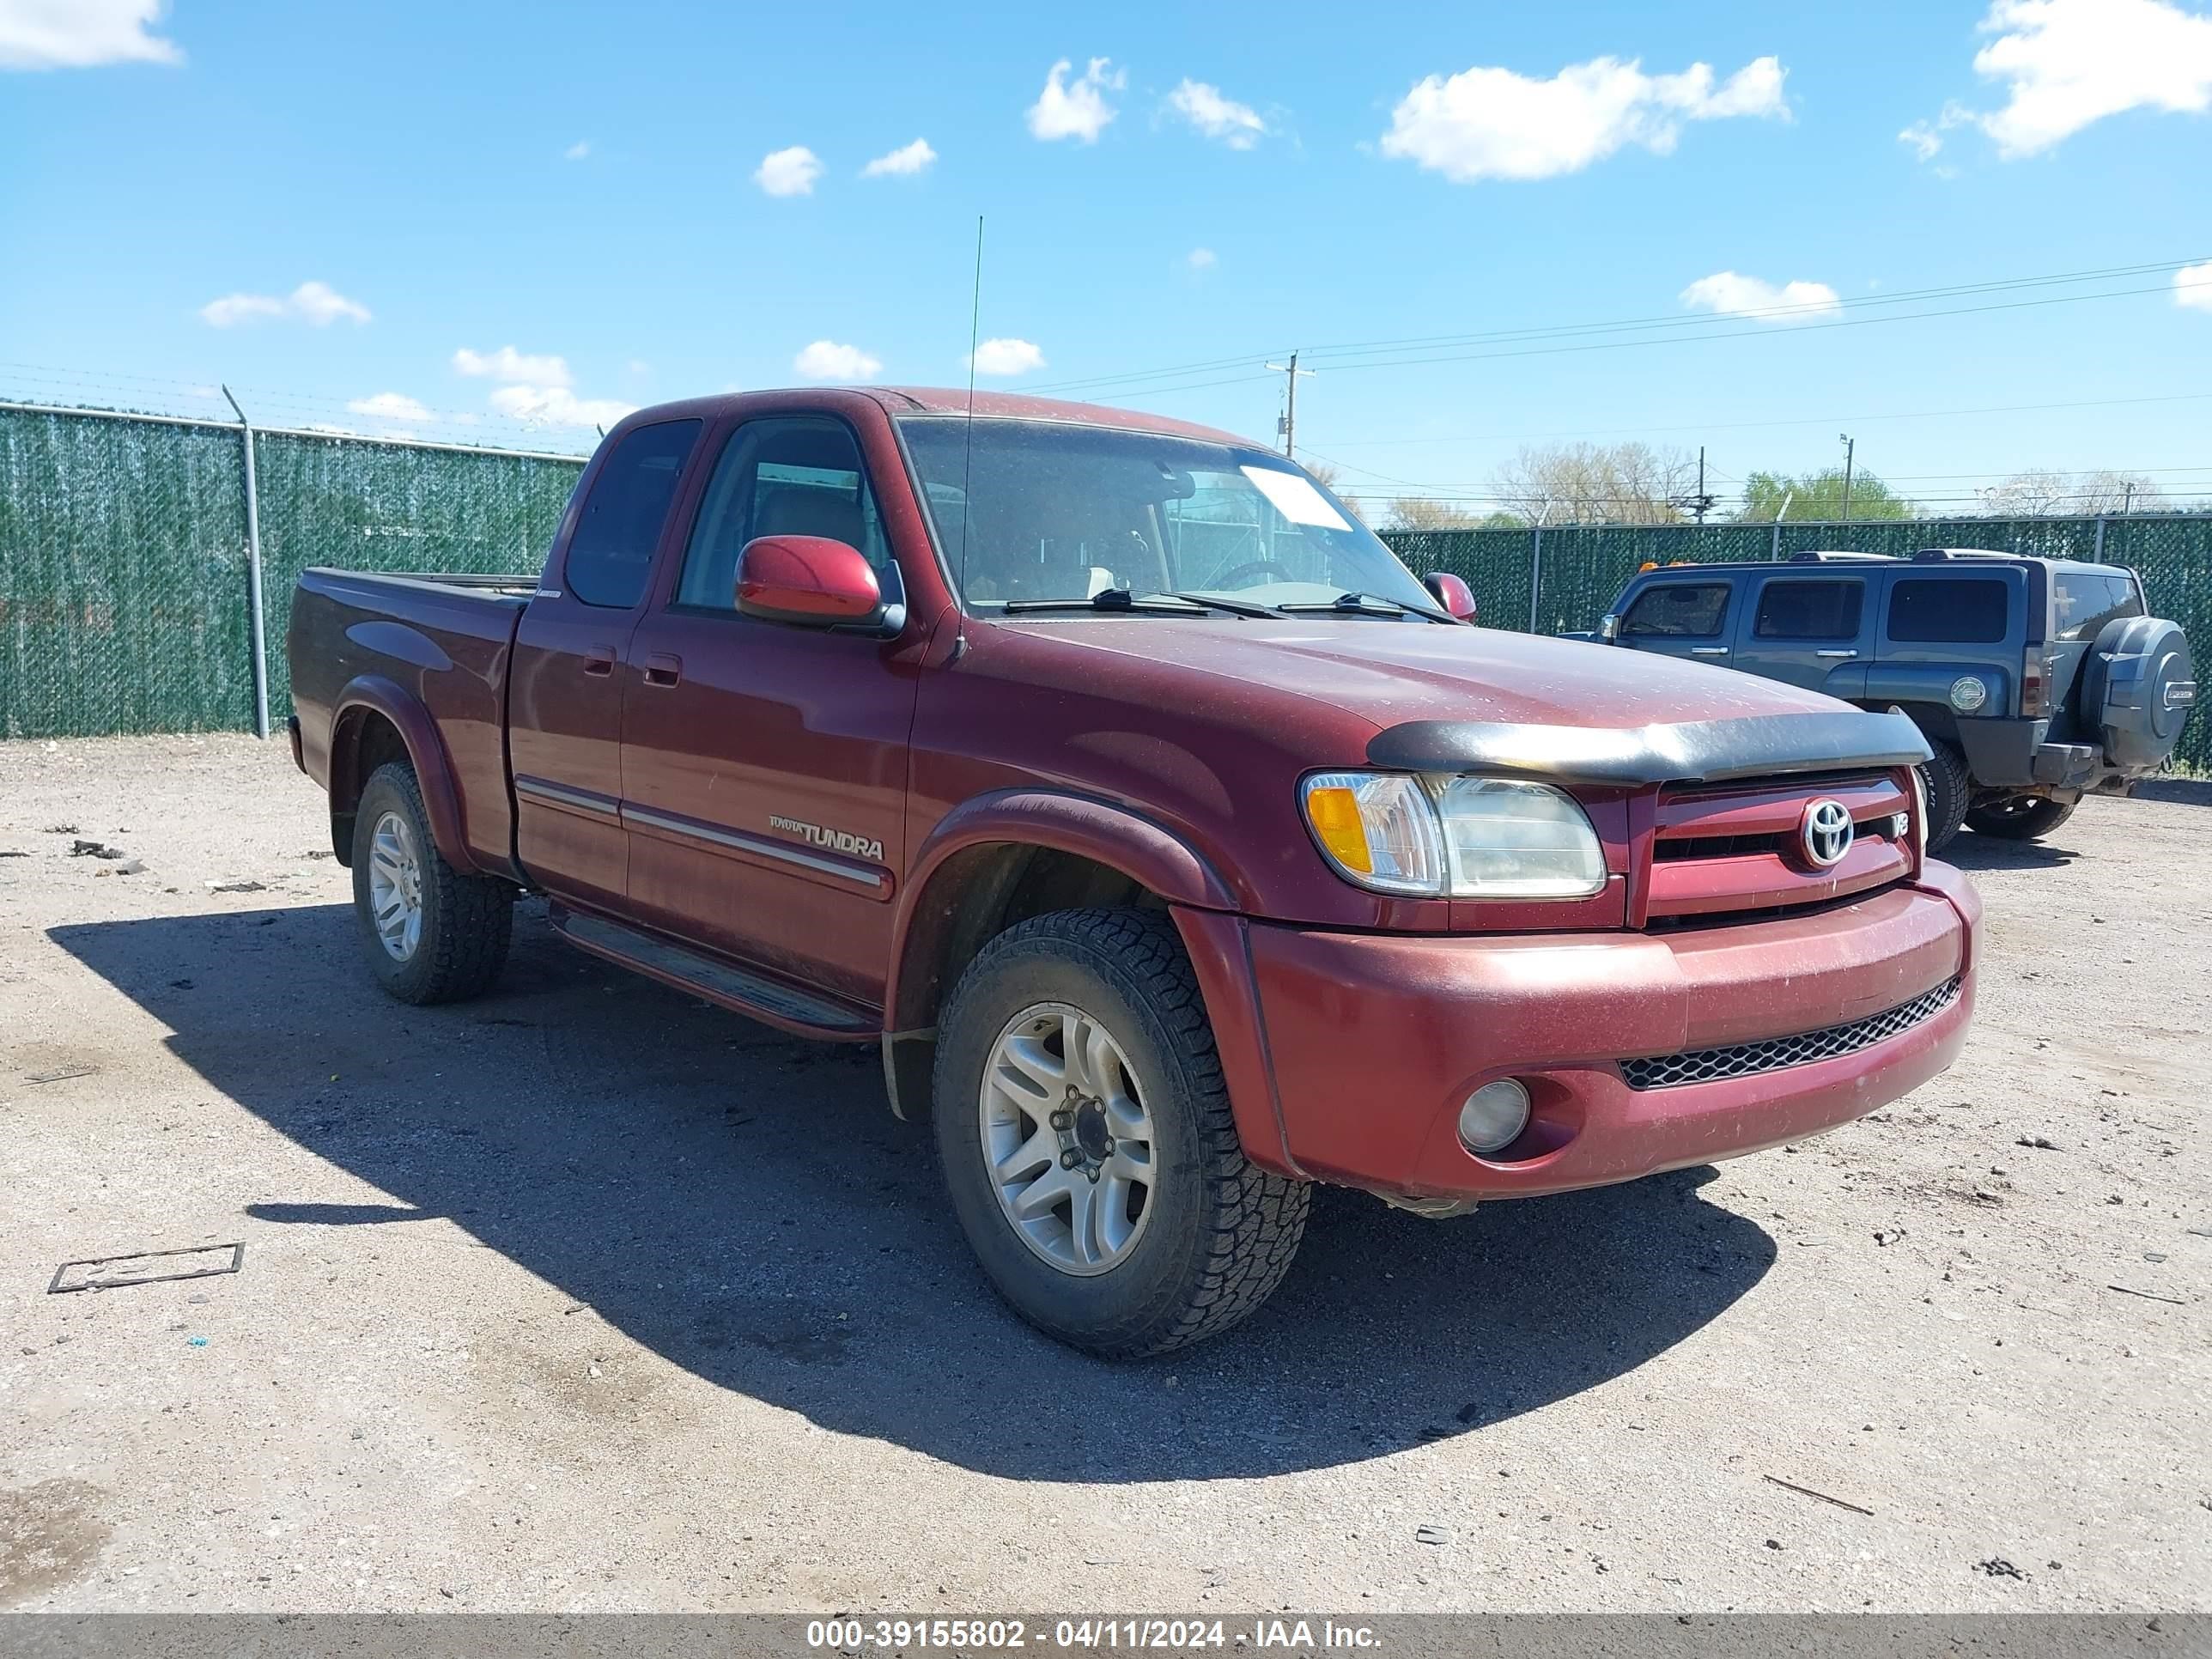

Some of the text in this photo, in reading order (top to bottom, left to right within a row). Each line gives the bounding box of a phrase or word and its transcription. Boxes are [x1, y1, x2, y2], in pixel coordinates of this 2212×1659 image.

[769, 816, 884, 860] TOYOTA TUNDRA
[1891, 812, 1909, 839] V8
